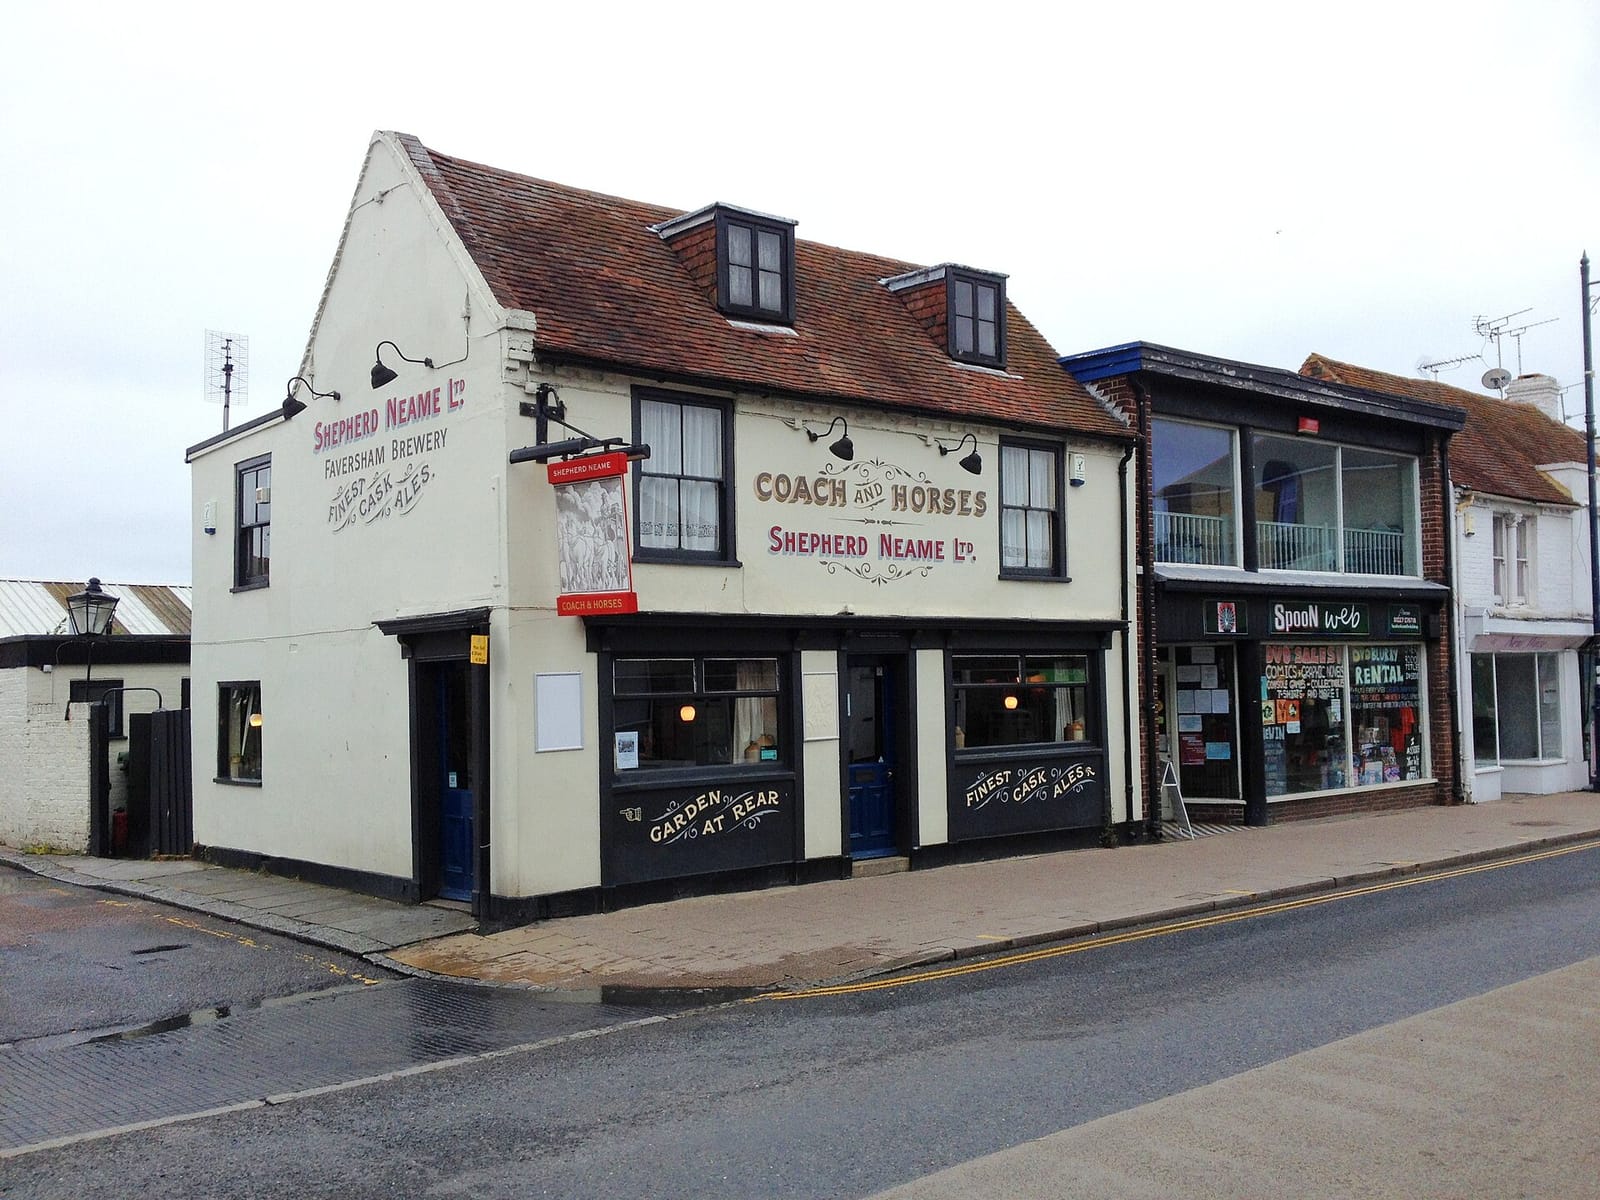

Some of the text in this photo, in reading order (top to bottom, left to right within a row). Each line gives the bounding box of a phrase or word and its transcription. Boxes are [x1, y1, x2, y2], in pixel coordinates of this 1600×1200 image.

[314, 408, 379, 452] SHEPHERD
[386, 387, 441, 430] NEAME
[324, 428, 448, 479] FAVERSHAM BREWERY
[553, 461, 612, 477] SHEPHERD NEAME
[328, 478, 366, 522] FINEST
[359, 473, 393, 516] CASK
[754, 472, 987, 517] COACH AND HORSES
[769, 525, 868, 557] SHEPHERD
[880, 533, 945, 560] NEAME
[562, 598, 623, 611] COACH & HORSES
[1325, 603, 1360, 629] web
[1266, 664, 1297, 679] COMICS
[1355, 665, 1404, 685] RENTAL
[966, 770, 1012, 807] FINEST
[1013, 770, 1047, 801] CASK
[1054, 766, 1084, 798] ALES
[650, 790, 779, 842] GARDEN AT REAR
